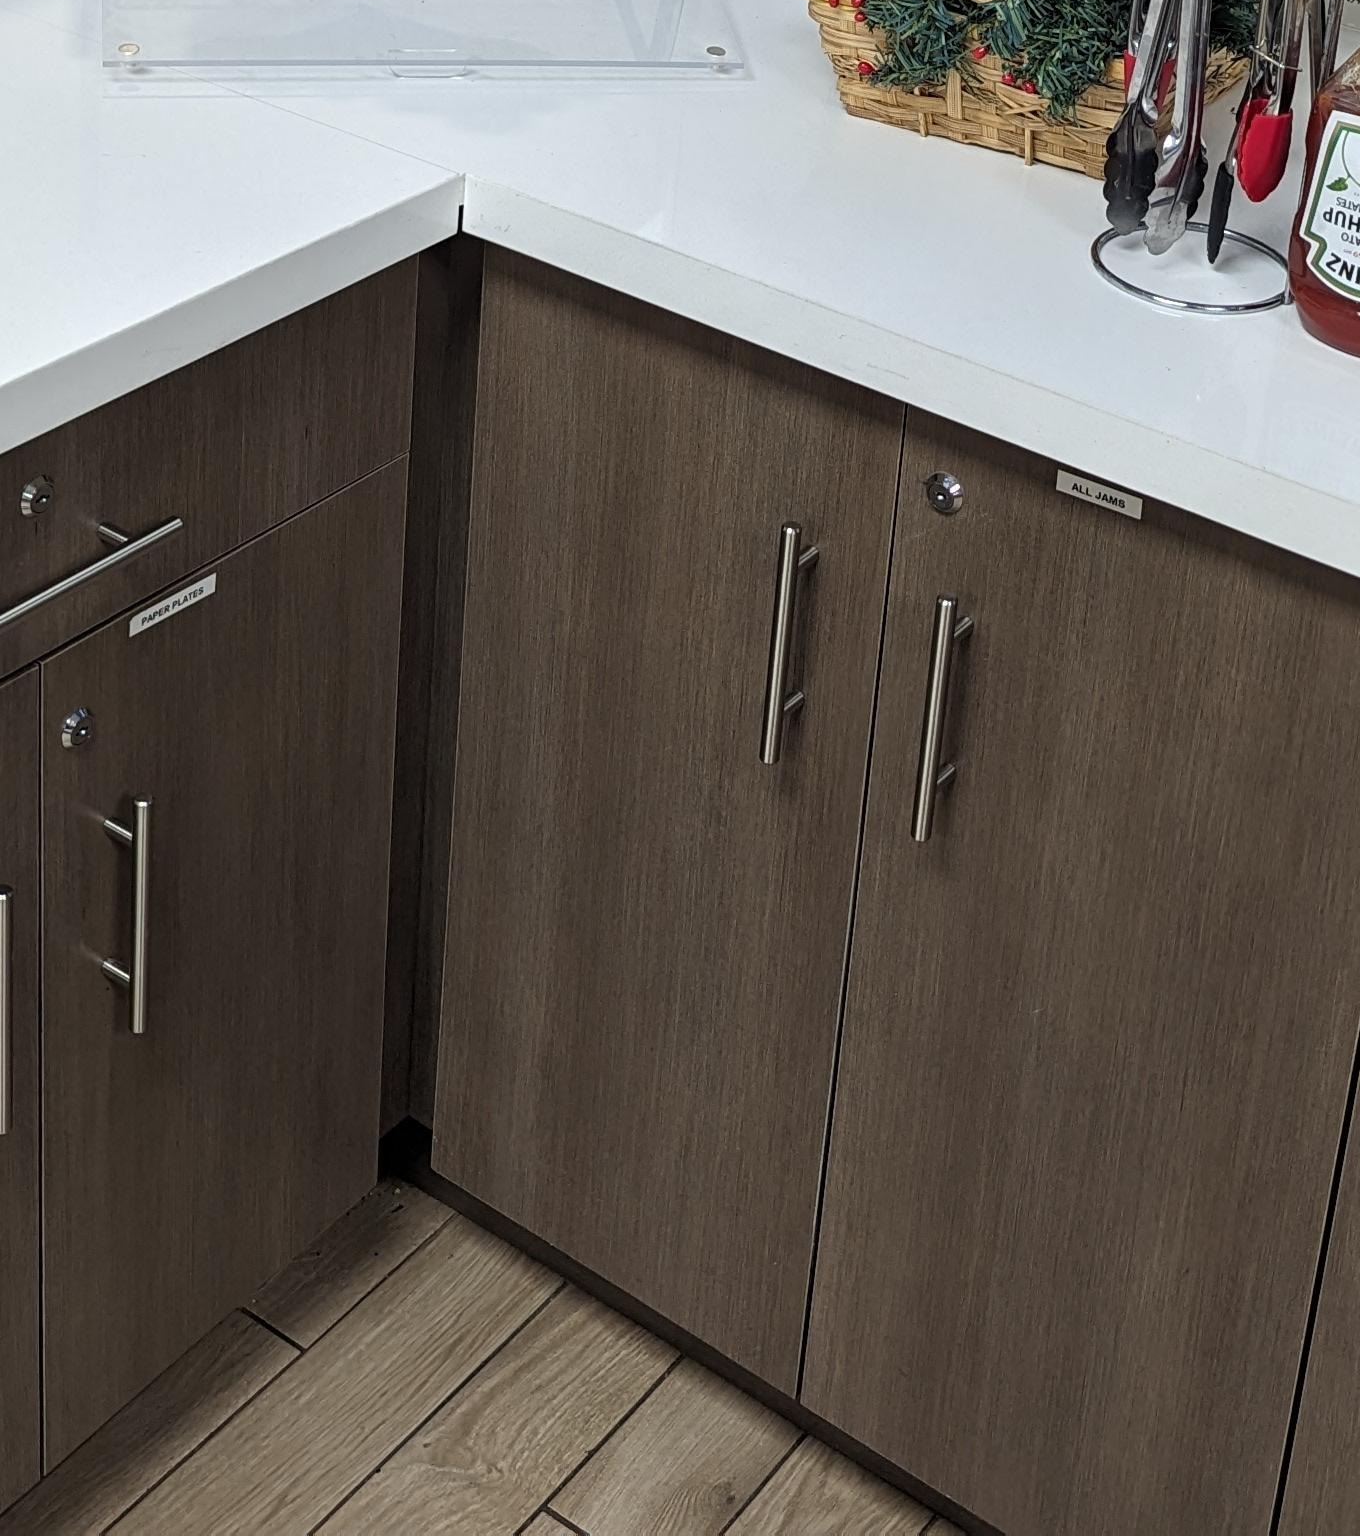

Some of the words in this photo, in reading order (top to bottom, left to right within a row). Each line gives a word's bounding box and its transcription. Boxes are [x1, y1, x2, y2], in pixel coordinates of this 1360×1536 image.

[1071, 482, 1093, 497] ALL
[141, 604, 171, 627] PAPER
[171, 586, 204, 610] PLATES
